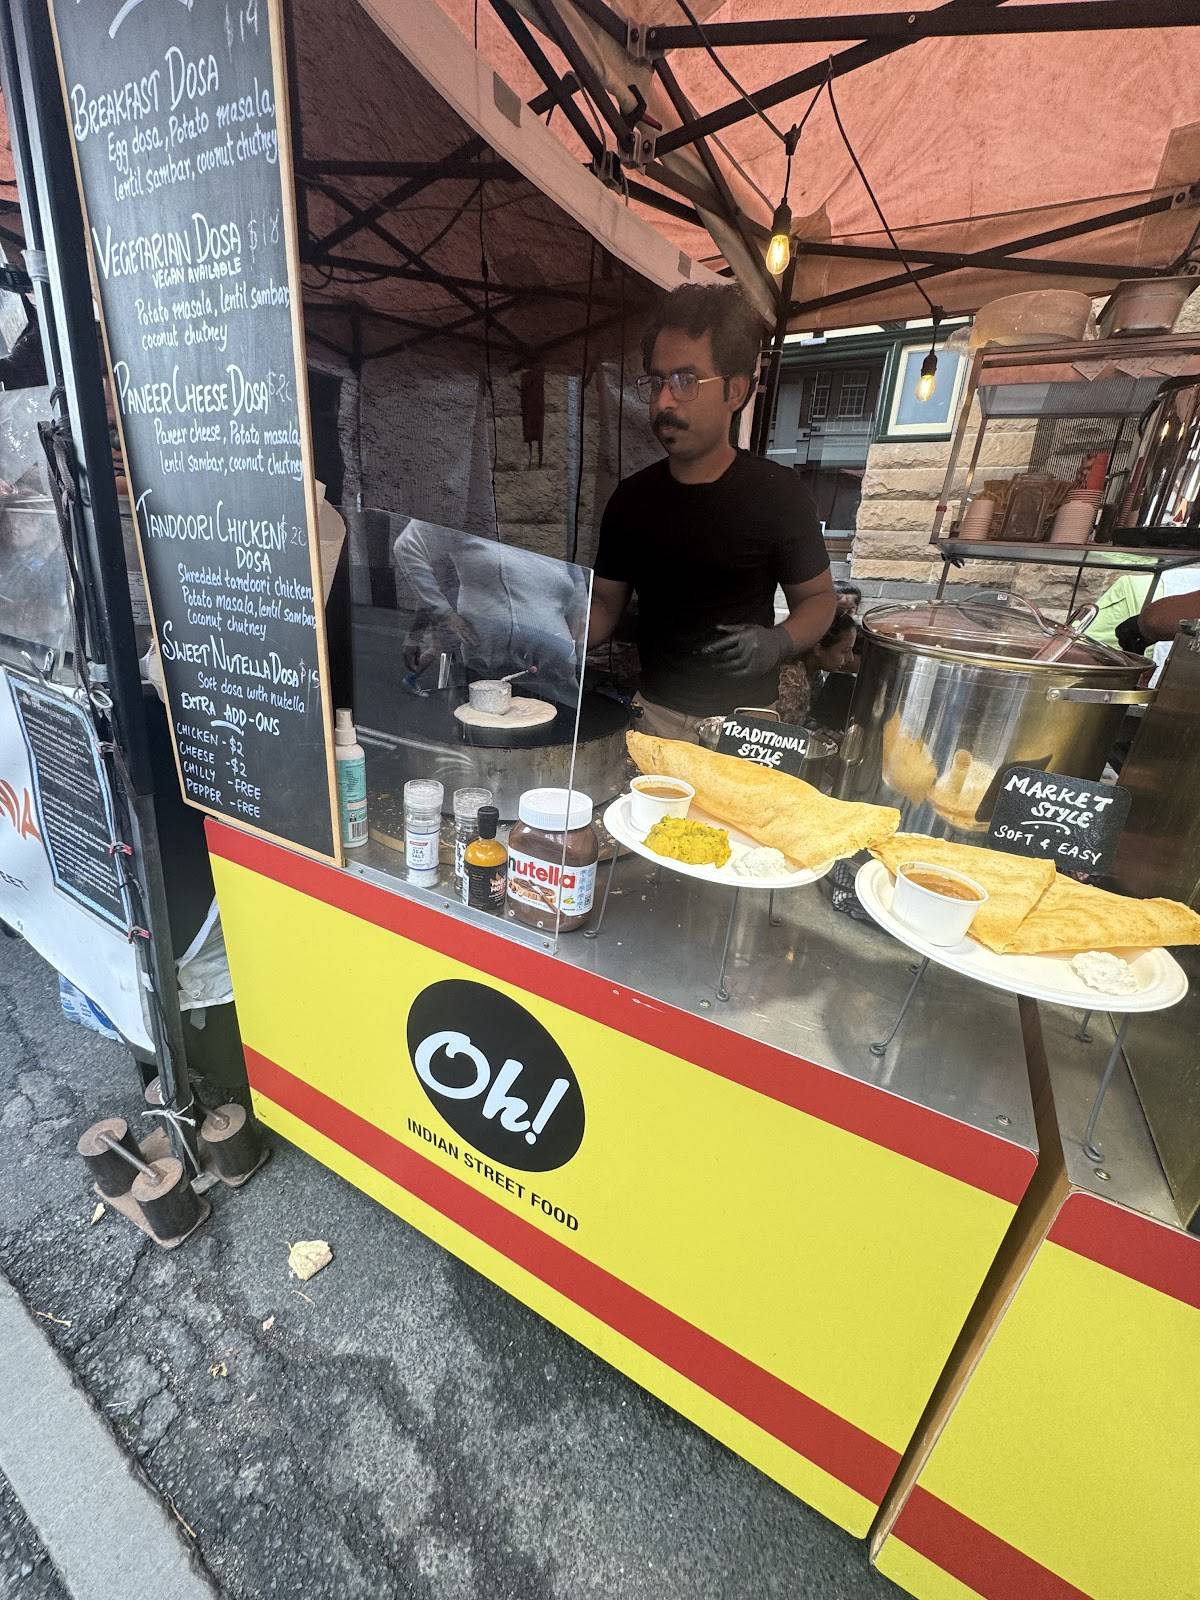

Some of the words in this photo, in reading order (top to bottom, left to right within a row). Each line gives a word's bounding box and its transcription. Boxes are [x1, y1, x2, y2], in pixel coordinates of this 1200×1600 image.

[71, 69, 161, 141] BREAKFAST
[165, 45, 220, 111] DOSA
[108, 131, 129, 175] Egg
[169, 106, 209, 148] Potato
[216, 77, 276, 128] masala,
[113, 166, 144, 201] lentil
[146, 153, 195, 194] sambar,
[197, 131, 235, 174] coconut
[237, 123, 279, 164] chutney
[92, 224, 192, 280] VEGETARIAN
[192, 212, 241, 264] DOSA
[152, 264, 185, 290] VEGAN
[188, 257, 242, 285] AVAILABLE
[135, 297, 170, 326] Potato
[172, 289, 217, 320] masala,
[220, 280, 249, 318] lentil
[142, 324, 179, 351] coconut
[185, 320, 229, 352] chutney
[113, 361, 171, 415] PANEER
[172, 364, 229, 413] CHEESE
[226, 364, 268, 416] DOSA
[154, 418, 187, 446] Paneer
[230, 420, 260, 446] Potato
[159, 450, 184, 476] lentil
[187, 448, 228, 477] sambar,
[229, 448, 264, 474] coconut
[268, 450, 304, 482] chutney
[136, 488, 214, 541] TANDOORI
[216, 500, 281, 551] CHICKEN
[236, 546, 272, 574] DOSA
[178, 562, 222, 587] Shredded
[225, 570, 271, 596] tandoori
[182, 585, 213, 610] Potato
[216, 594, 258, 619] masala,
[258, 598, 282, 620] lentil
[227, 614, 268, 641] chutney
[161, 620, 210, 666] SWEET
[209, 634, 271, 680] NUTELLA
[269, 651, 299, 688] DOSA
[181, 692, 216, 717] EXTRA
[197, 671, 217, 689] Soft
[221, 679, 243, 699] dosa
[246, 685, 269, 703] with
[271, 690, 305, 714] nutella
[176, 722, 219, 747] CHICKEN
[723, 720, 806, 755] TRADITIONAL
[179, 741, 215, 765] CHEESE
[738, 743, 783, 766] STYLE
[184, 761, 216, 783] CHILLY
[185, 779, 224, 806] PEPPER
[1004, 774, 1113, 812] MARKET
[1031, 801, 1094, 829] STYLE
[994, 825, 1035, 846] SOFT
[1040, 838, 1051, 850] &
[1057, 843, 1102, 866] EASY
[508, 855, 576, 889] nutella
[414, 1030, 571, 1146] Oh!
[407, 1117, 459, 1160] INDIAN
[463, 1151, 526, 1199] STREET
[530, 1191, 580, 1232] FOOD
